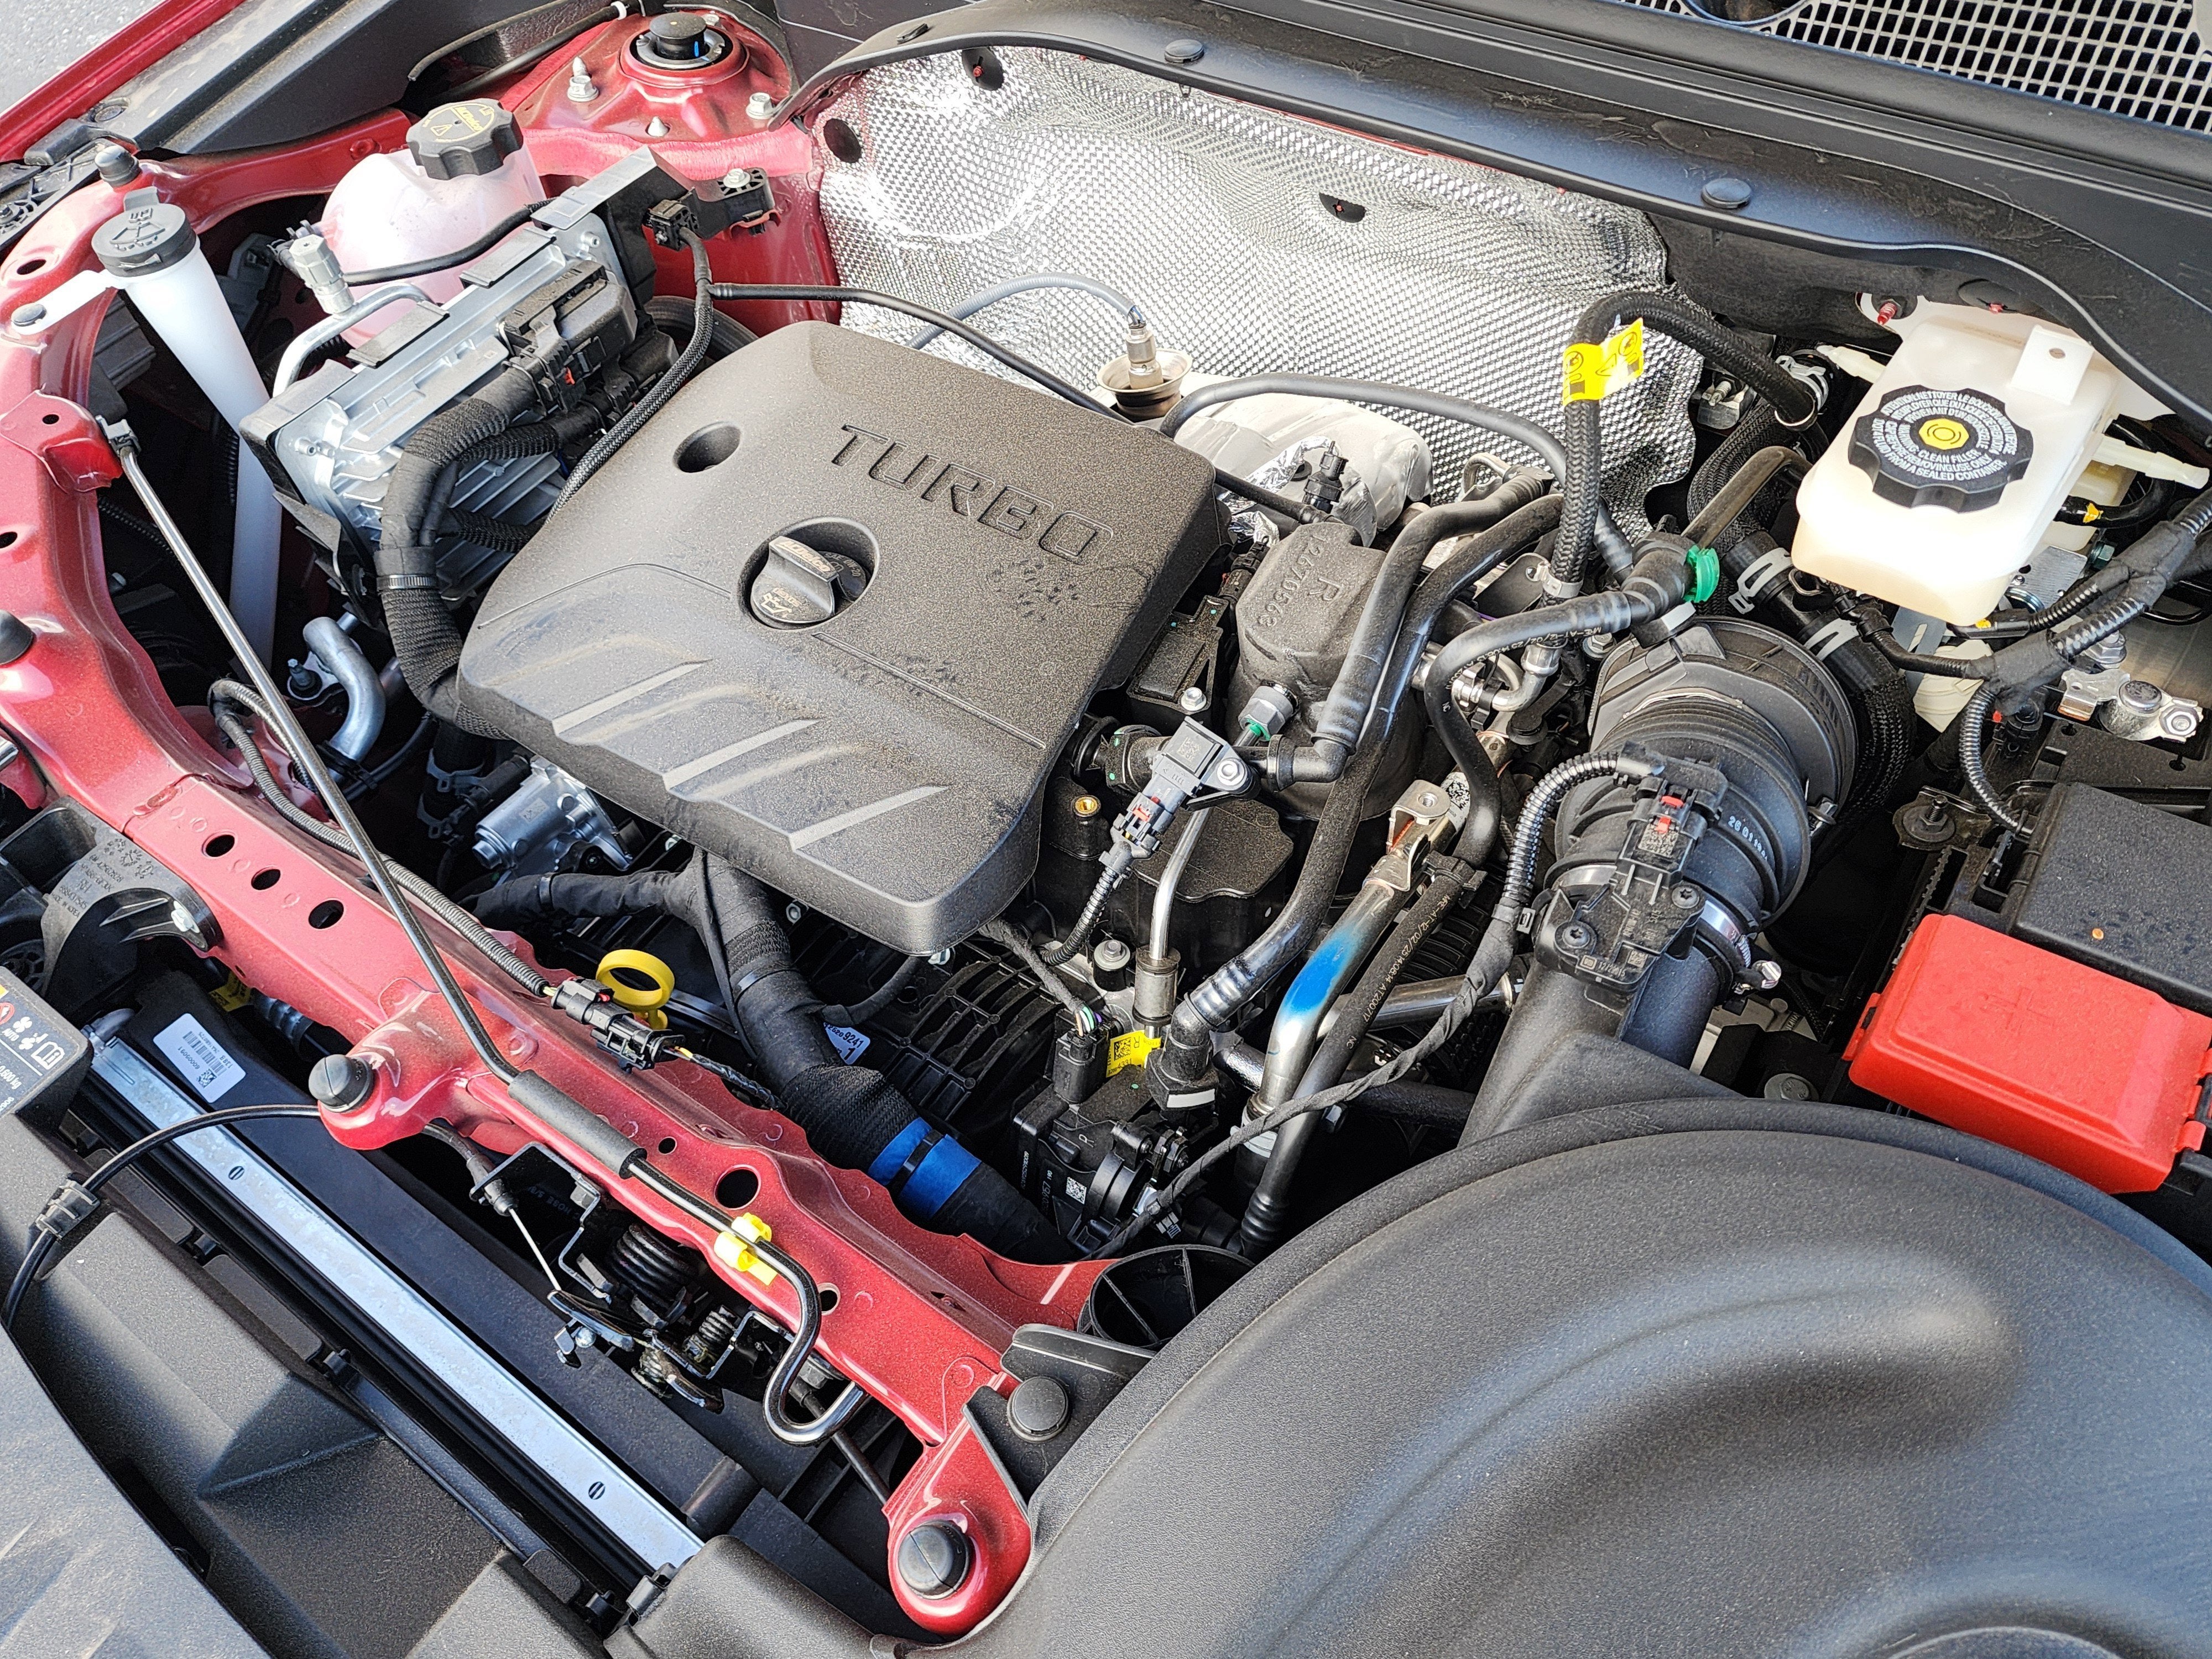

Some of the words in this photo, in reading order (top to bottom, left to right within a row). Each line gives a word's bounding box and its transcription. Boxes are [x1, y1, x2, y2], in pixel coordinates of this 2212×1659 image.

[1918, 449, 1950, 463] CLEAN
[1952, 448, 1982, 463] FILLER
[1915, 467, 1955, 481] SEALED
[831, 423, 1113, 566] TURBO
[780, 540, 832, 573] ACDelco
[1307, 577, 1343, 601] R
[1362, 984, 1387, 1022] AT200717
[2, 1027, 20, 1041] AUTO
[842, 1031, 864, 1048] 9241
[1346, 1036, 1358, 1050] NC
[1078, 1134, 1095, 1148] R
